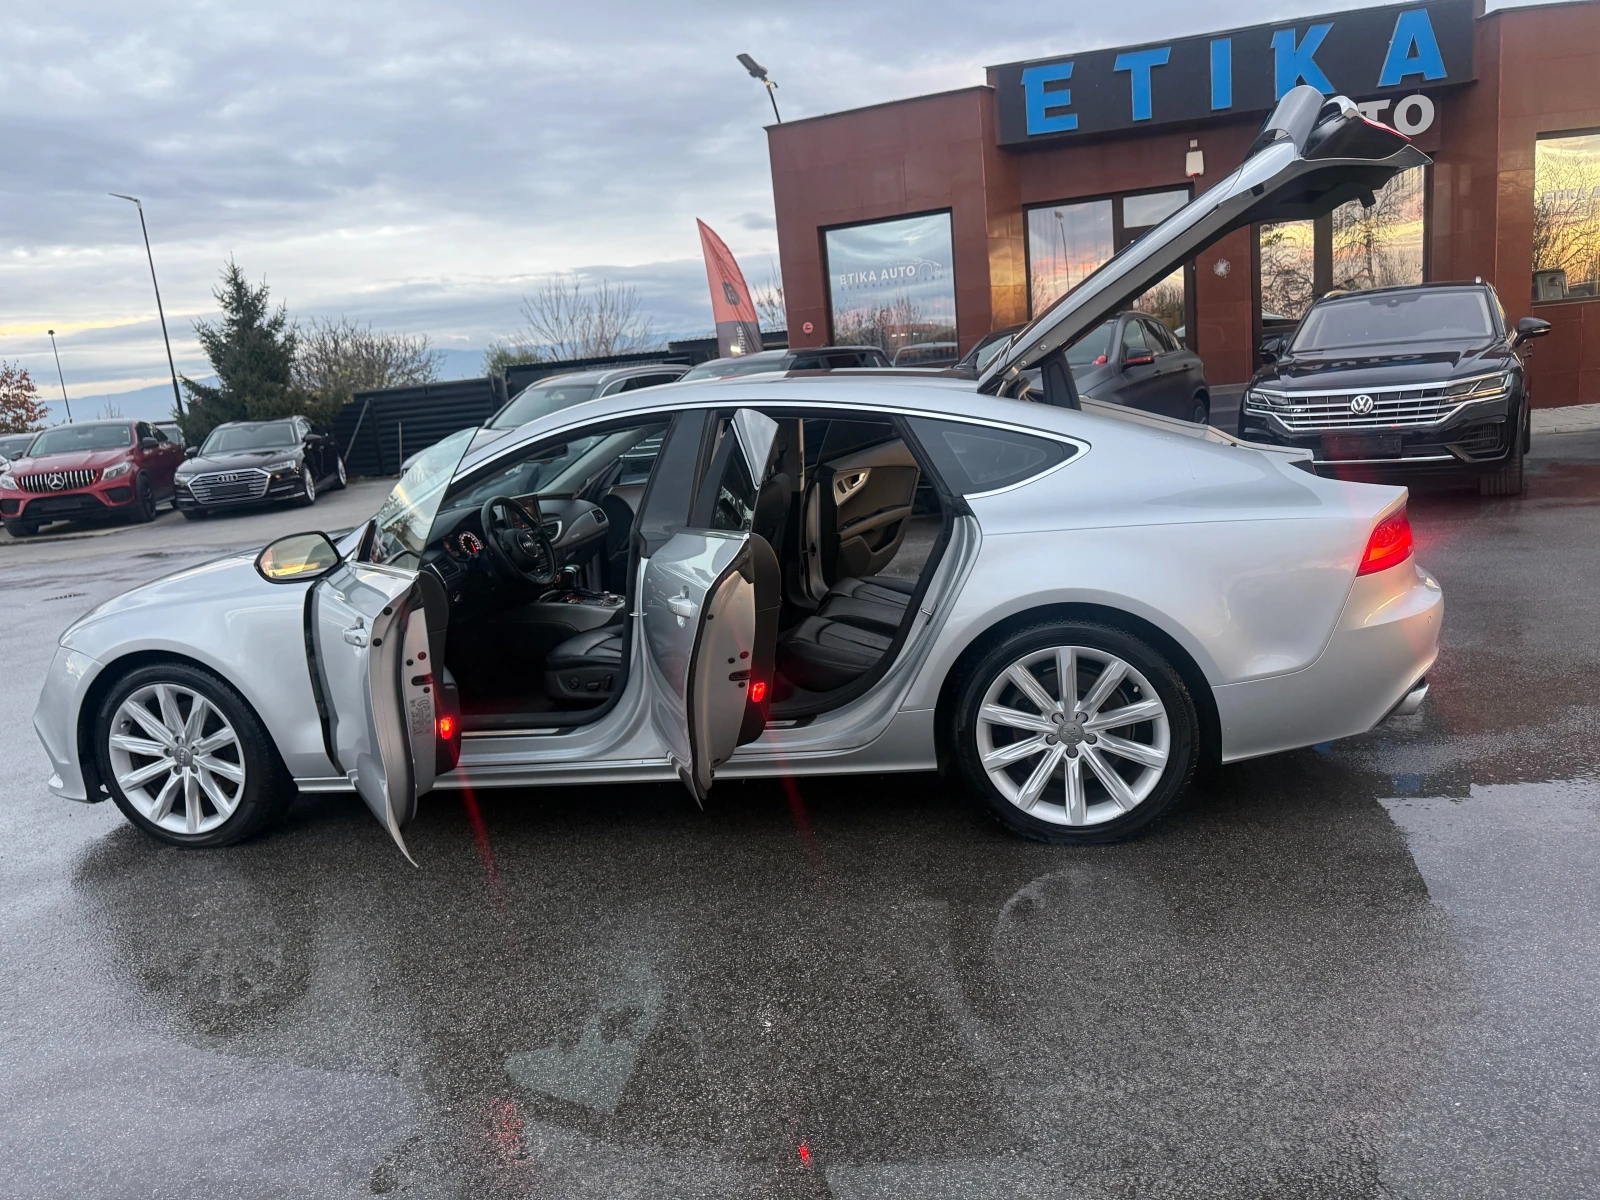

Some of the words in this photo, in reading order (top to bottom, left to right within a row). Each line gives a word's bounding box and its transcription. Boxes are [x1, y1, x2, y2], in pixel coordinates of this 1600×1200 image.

[1021, 8, 1447, 135] ETIKA
[1358, 94, 1435, 136] TO
[840, 270, 877, 285] ETIKA
[881, 265, 916, 281] AUTO
